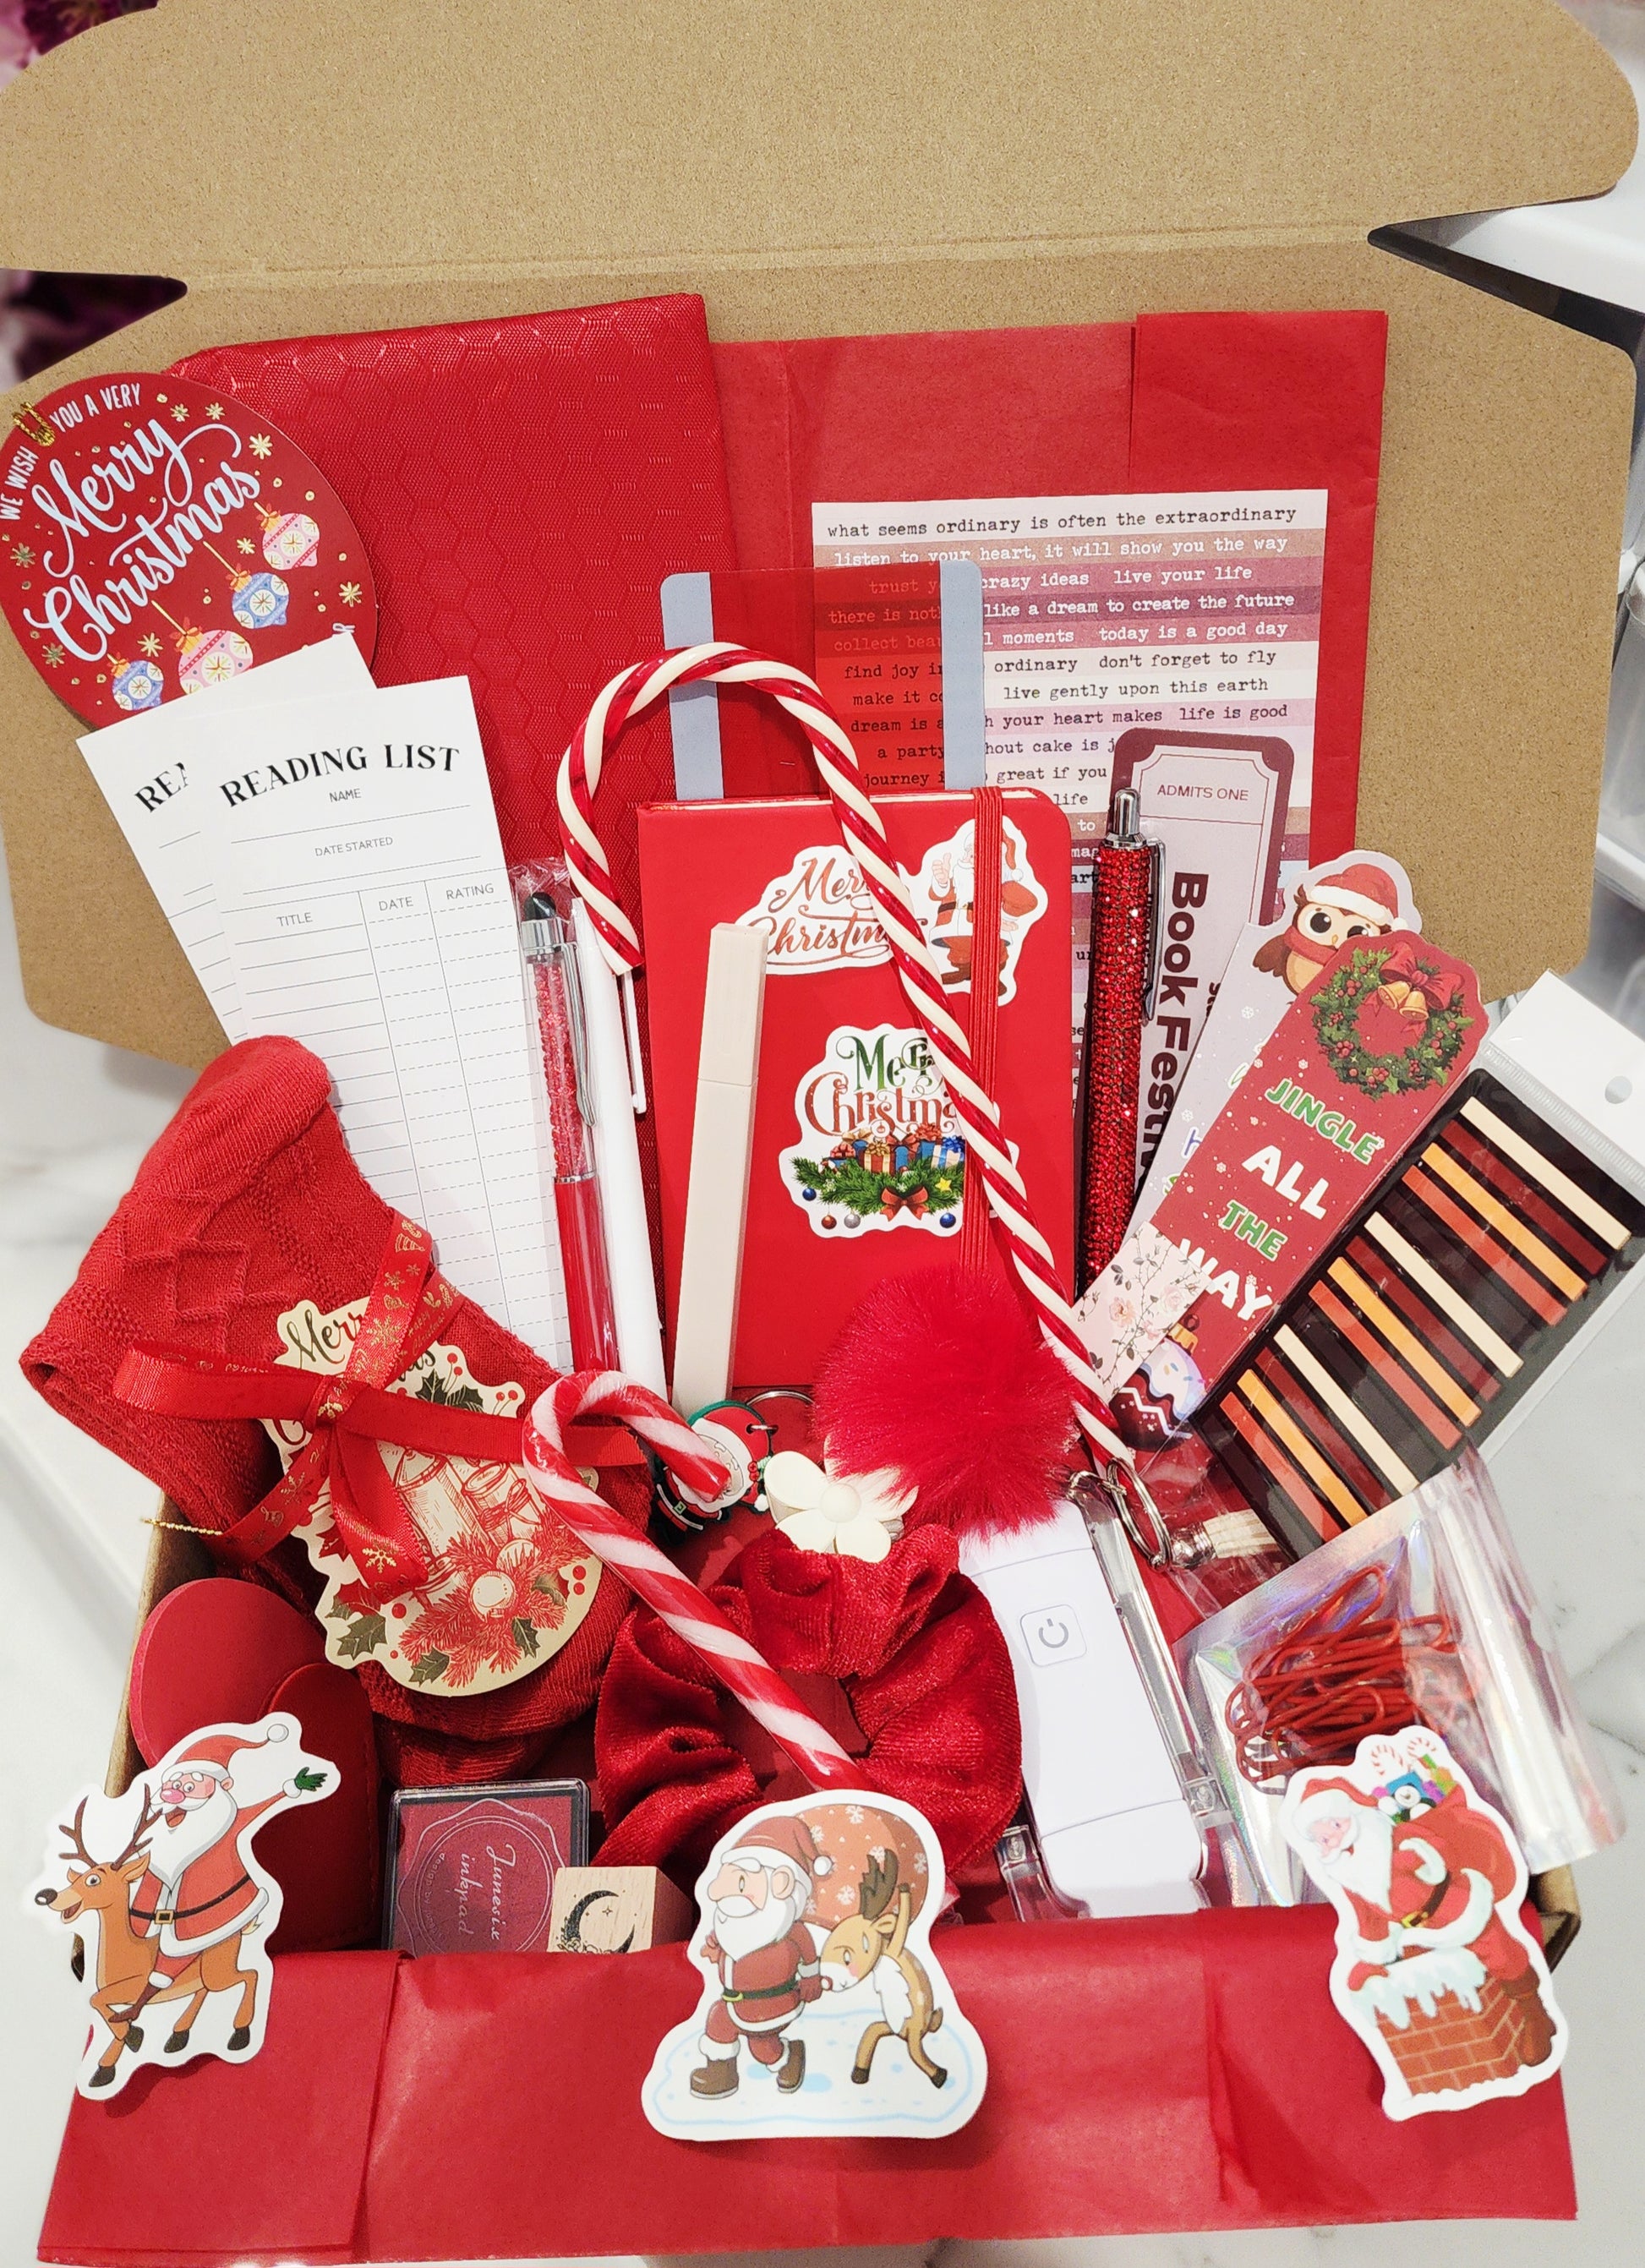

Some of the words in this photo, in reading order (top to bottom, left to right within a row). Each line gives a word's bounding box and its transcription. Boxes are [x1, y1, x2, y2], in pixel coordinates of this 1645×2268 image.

[85, 394, 100, 417] A
[100, 382, 140, 411] VERY
[48, 401, 84, 433] YOU
[4, 445, 40, 489] WISH
[0, 493, 24, 520] WE
[31, 418, 242, 578] Merry
[828, 524, 869, 538] what
[878, 523, 927, 537] seems
[937, 518, 1020, 533] ordinary
[1030, 516, 1048, 530] is
[1058, 514, 1107, 528] often
[1116, 512, 1145, 526] the
[1156, 508, 1297, 523] extraordinary
[834, 553, 890, 566] listen
[900, 550, 919, 564] to
[928, 549, 971, 566] your
[980, 545, 1036, 560] heart,
[1044, 544, 1063, 558] it
[1073, 542, 1112, 556] will
[1120, 540, 1162, 555] show
[1172, 541, 1205, 556] you
[1214, 538, 1244, 551] the
[1254, 538, 1287, 552] way
[24, 461, 260, 662] Christmas
[1040, 572, 1089, 587] ideas
[1113, 571, 1152, 584] live
[1161, 569, 1206, 584] your
[1215, 566, 1253, 581] life
[869, 580, 919, 593] trust
[984, 604, 1019, 617] like
[1029, 605, 1039, 615] a
[1047, 601, 1098, 615] dream
[1107, 599, 1124, 612] to
[1133, 597, 1189, 611] create
[1198, 595, 1227, 609] the
[1234, 594, 1295, 609] future
[828, 609, 875, 624] there
[883, 609, 900, 621] is
[1003, 631, 1074, 645] moments
[1099, 626, 1149, 642] today
[1158, 625, 1177, 638] is
[1186, 626, 1197, 638] a
[1206, 623, 1246, 639] good
[1255, 621, 1288, 637] day
[834, 637, 898, 652] collect
[994, 659, 1078, 673] ordinary
[1099, 653, 1142, 669] don't
[1150, 652, 1211, 669] forget
[1220, 651, 1238, 664] to
[1247, 650, 1276, 665] fly
[844, 664, 882, 679] find
[892, 664, 919, 680] joy
[852, 691, 894, 707] make
[903, 690, 921, 703] it
[1003, 687, 1040, 700] live
[1050, 684, 1108, 701] gently
[1118, 682, 1160, 697] upon
[1169, 680, 1208, 693] this
[1217, 678, 1268, 691] earth
[1003, 714, 1044, 730] your
[1053, 711, 1103, 725] heart
[1112, 710, 1162, 723] makes
[1179, 708, 1215, 720] life
[1222, 706, 1241, 719] is
[1249, 704, 1287, 721] good
[850, 719, 902, 733] dream
[910, 717, 927, 730] is
[877, 748, 888, 757] a
[897, 746, 944, 760] party
[1033, 740, 1072, 752] cake
[1081, 738, 1099, 751] is
[219, 746, 368, 807] READING
[383, 744, 460, 772] LIST
[864, 771, 930, 787] journey
[997, 768, 1045, 784] great
[1052, 767, 1069, 779] if
[1078, 768, 1107, 780] you
[329, 788, 362, 803] NAME
[1054, 793, 1088, 806] life
[1157, 784, 1213, 798] ADMITS
[1217, 788, 1249, 801] ONE
[1078, 819, 1096, 832] to
[314, 844, 343, 857] DATE
[345, 836, 393, 852] STARTED
[445, 883, 495, 900] RATING
[378, 896, 414, 911] DATE
[276, 912, 313, 927] TITLE
[1160, 872, 1209, 1008] Book
[1266, 1079, 1381, 1163] JINGLE
[1242, 1145, 1329, 1220] ALL
[1221, 1200, 1287, 1260] THE
[1179, 1238, 1272, 1320] WAY
[454, 1853, 484, 1935] inkpad
